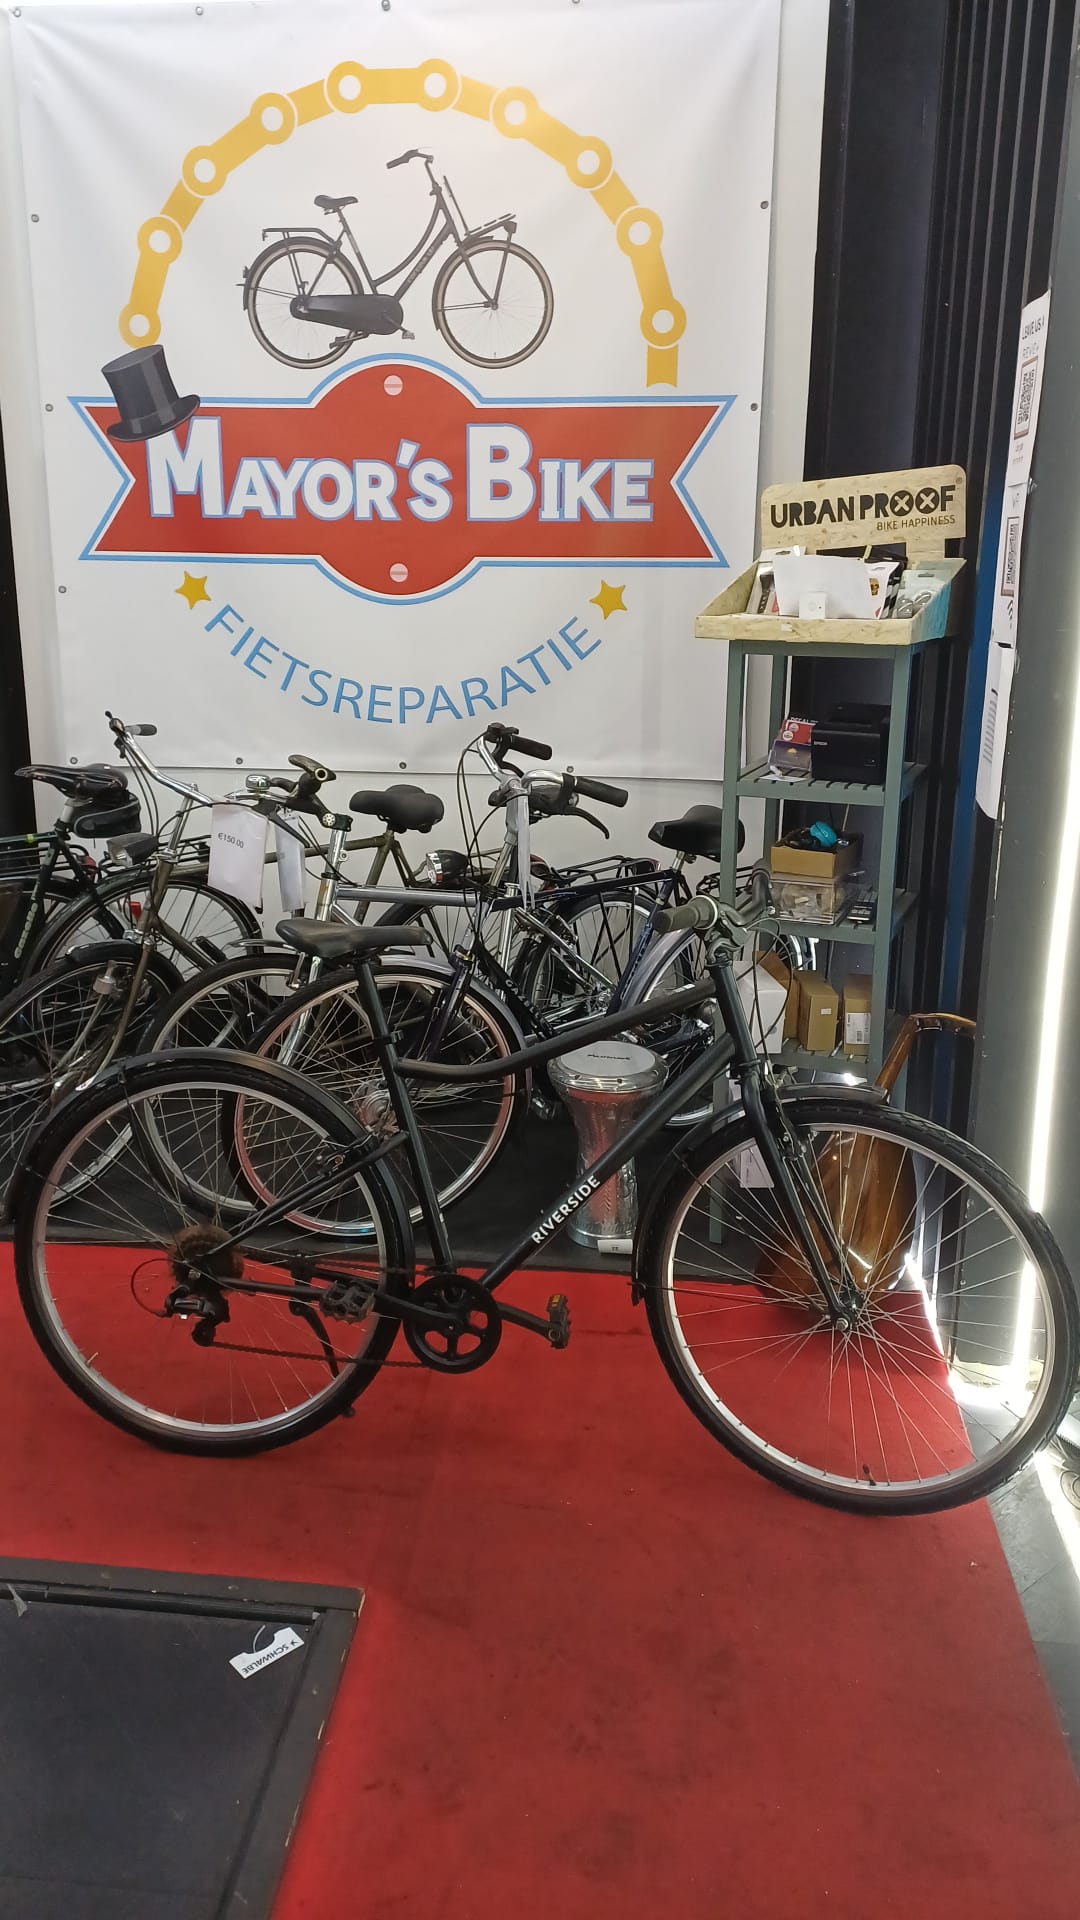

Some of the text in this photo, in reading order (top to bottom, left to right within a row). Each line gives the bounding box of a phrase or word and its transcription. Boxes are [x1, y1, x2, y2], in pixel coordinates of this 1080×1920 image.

[465, 423, 656, 523] BIKE
[876, 514, 956, 532] BIKE HAPPINESS
[203, 603, 603, 725] FIETSREPARATIE
[217, 831, 245, 849] €150.00
[530, 1174, 601, 1245] RIVERSIDE
[241, 1643, 290, 1674] SCHWALBE
